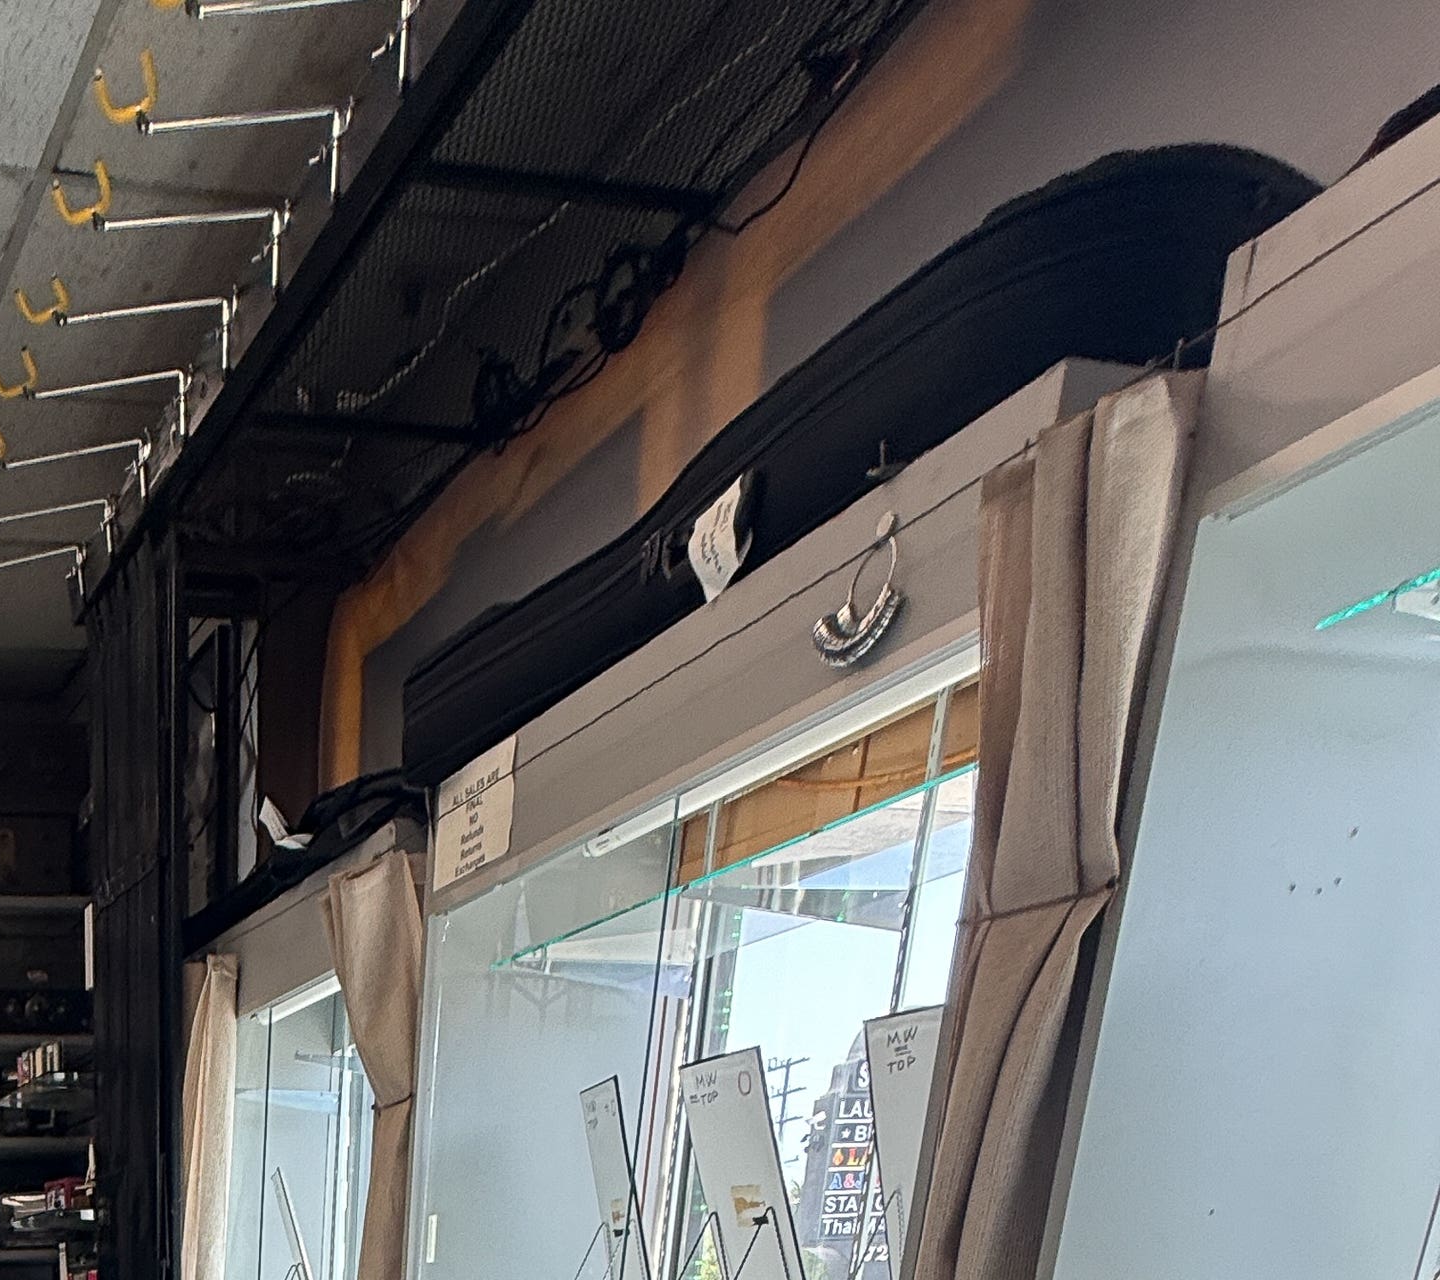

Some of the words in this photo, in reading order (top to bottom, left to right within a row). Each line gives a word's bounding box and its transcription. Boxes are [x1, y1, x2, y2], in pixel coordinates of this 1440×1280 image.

[464, 776, 485, 798] SALES
[486, 767, 501, 784] ARE
[465, 794, 484, 813] FINAL
[469, 812, 479, 827] NO
[887, 1025, 918, 1048] MW
[886, 1055, 916, 1075] TOP
[695, 1071, 718, 1088] MW
[698, 1091, 719, 1107] TOP
